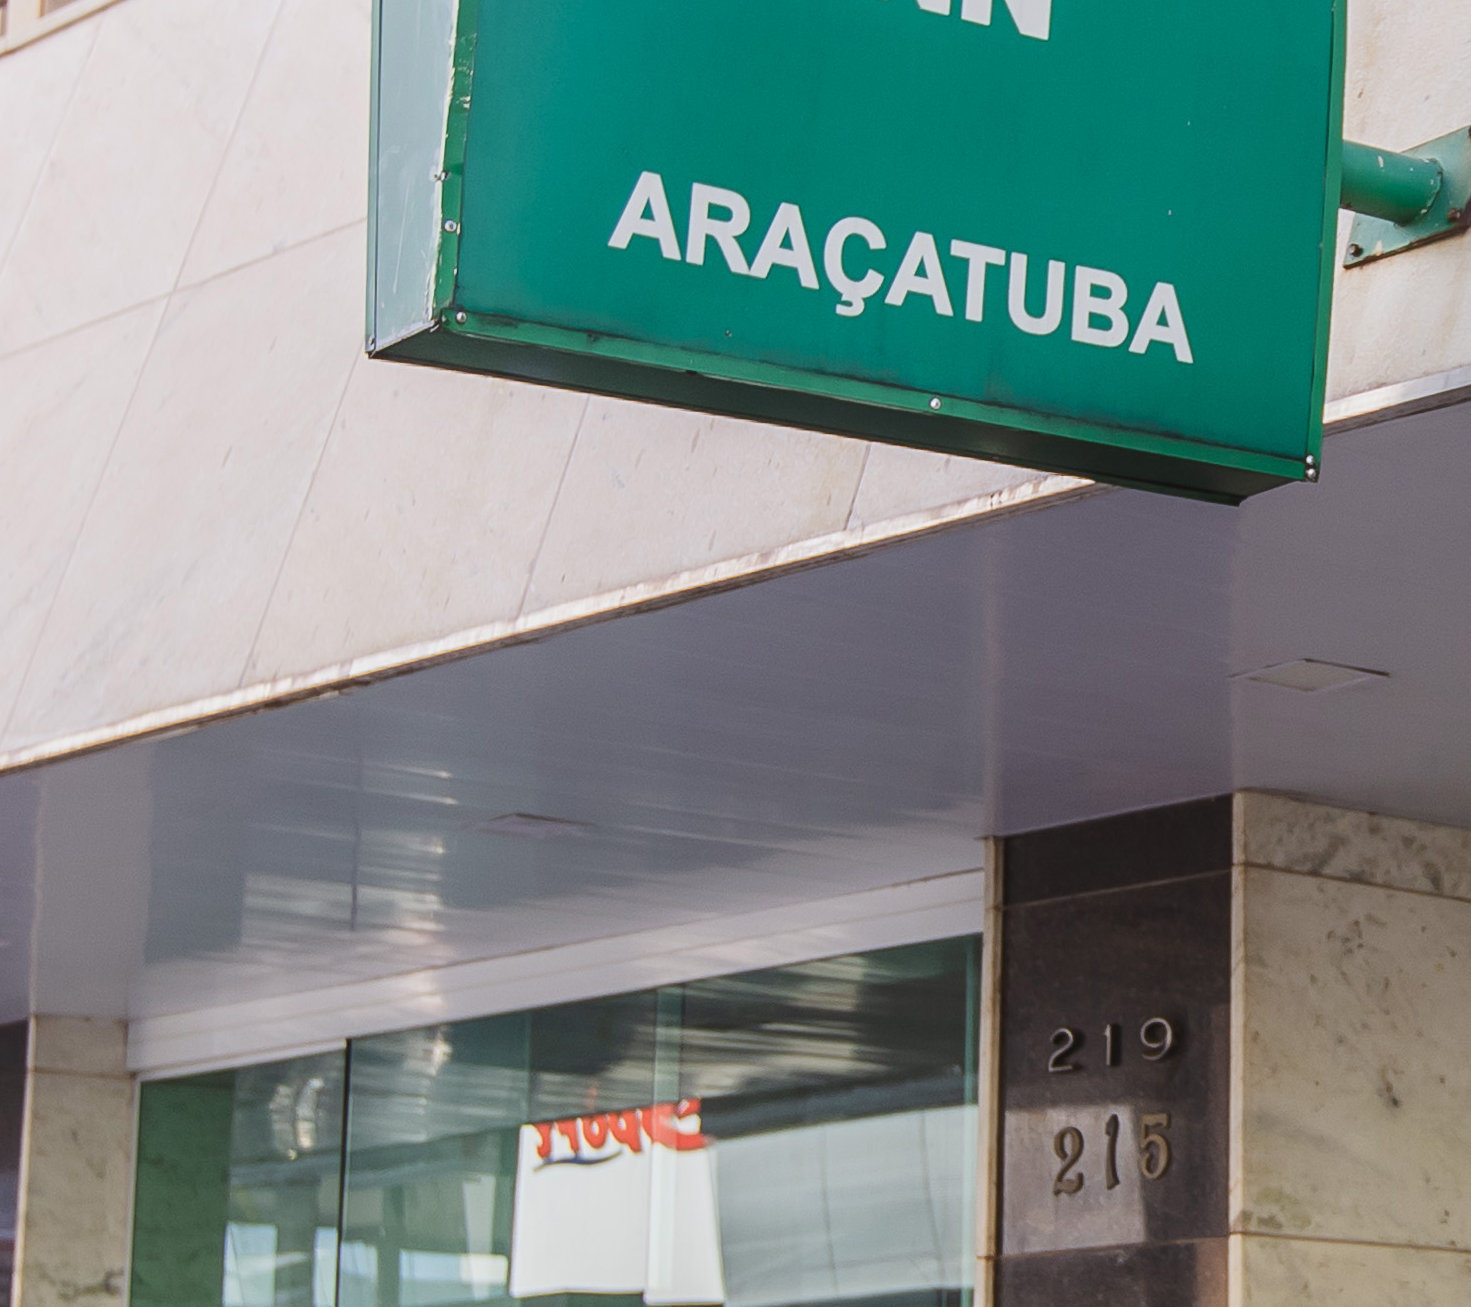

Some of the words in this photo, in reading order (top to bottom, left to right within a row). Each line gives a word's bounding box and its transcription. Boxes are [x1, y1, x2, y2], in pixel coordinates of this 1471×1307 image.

[608, 171, 1193, 364] ARAÇATUBA
[1047, 1016, 1177, 1073] 219
[1051, 1112, 1172, 1196] 215
